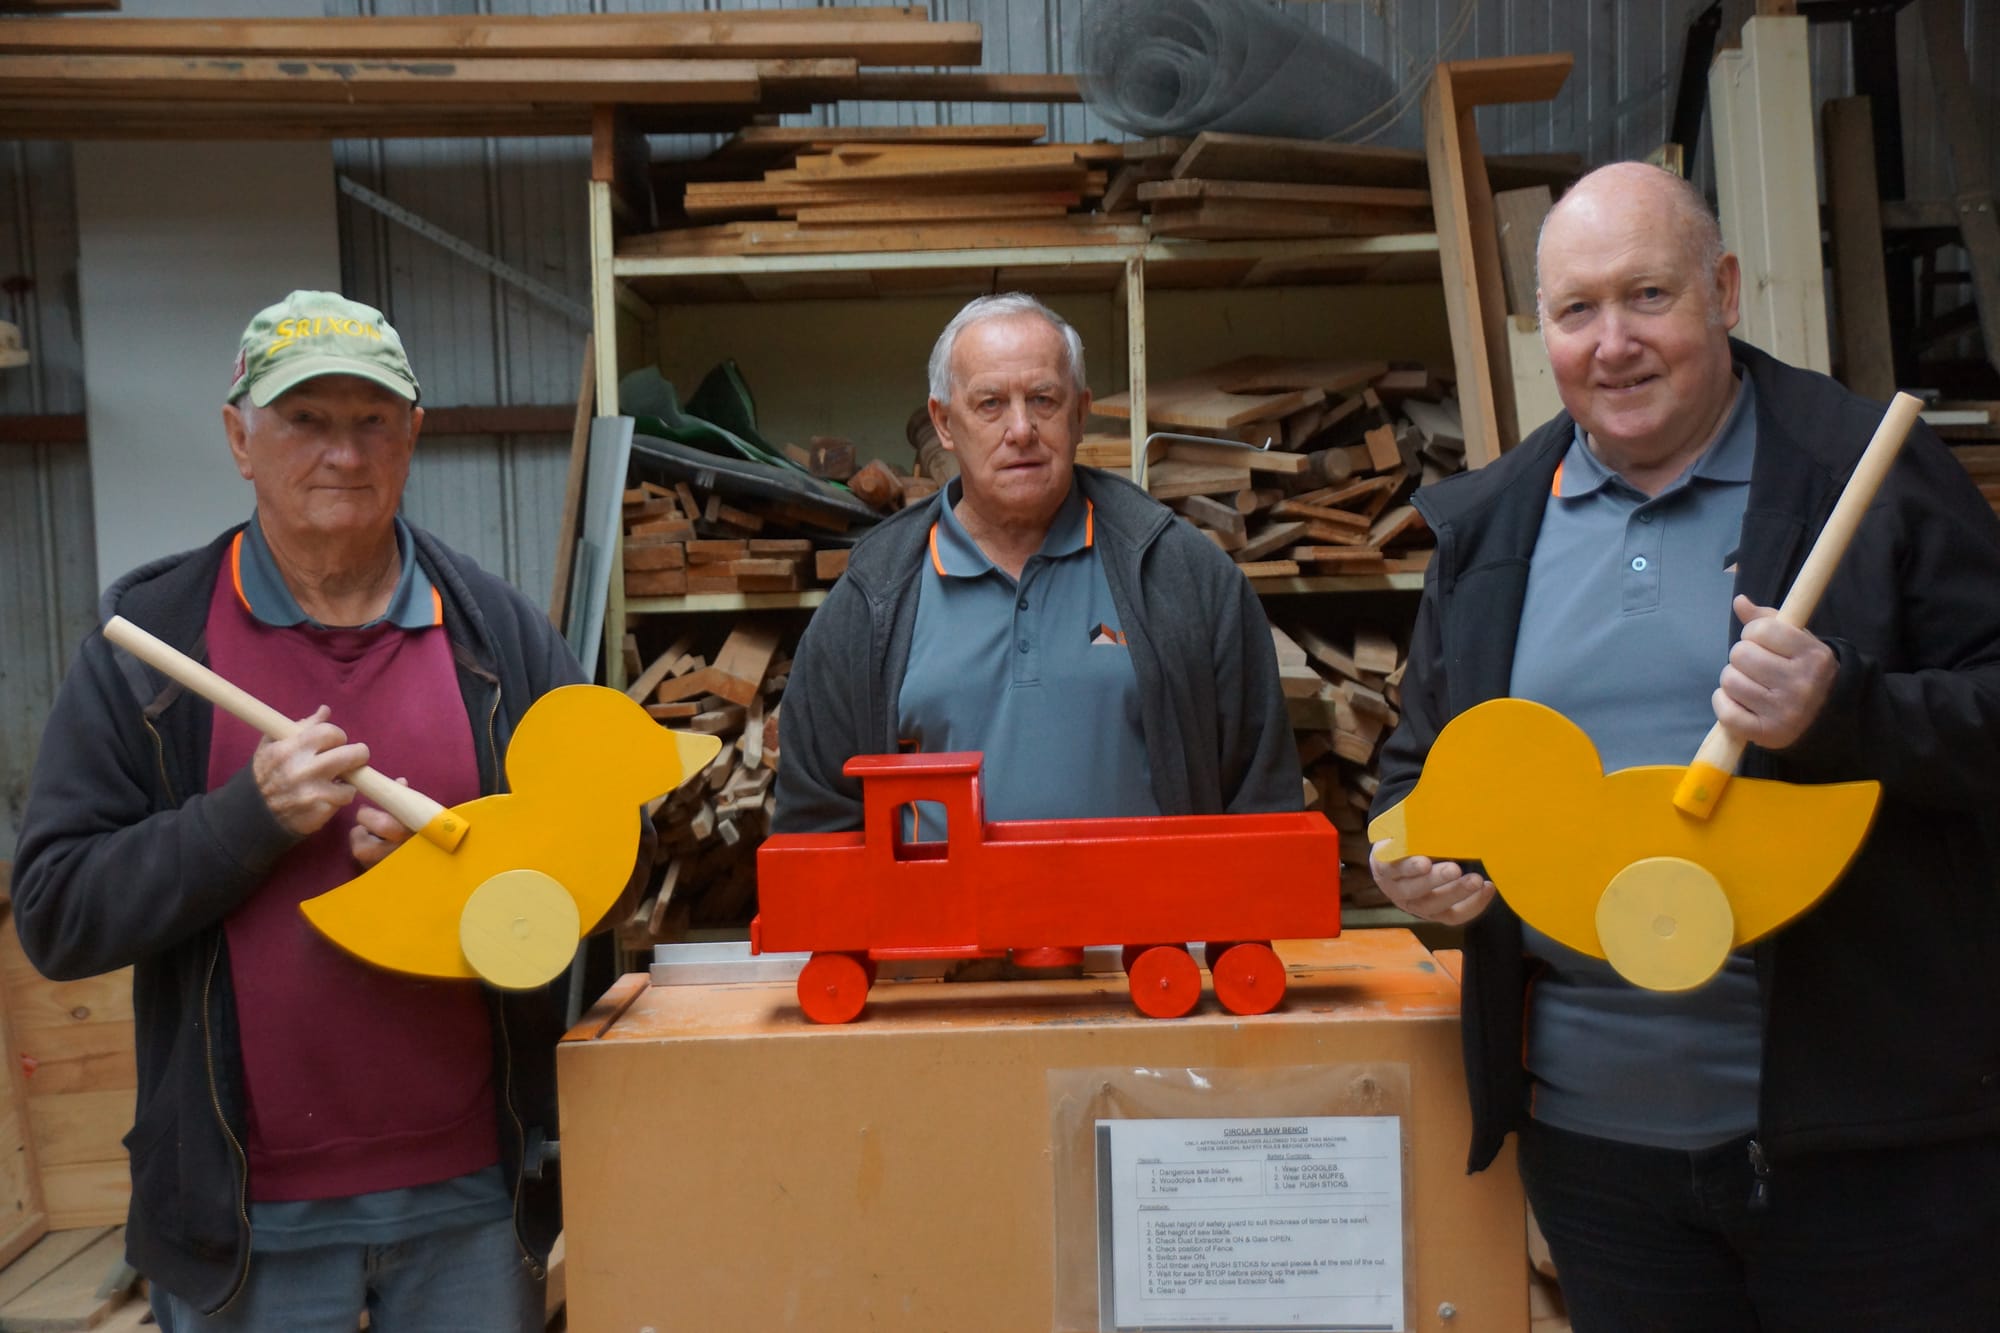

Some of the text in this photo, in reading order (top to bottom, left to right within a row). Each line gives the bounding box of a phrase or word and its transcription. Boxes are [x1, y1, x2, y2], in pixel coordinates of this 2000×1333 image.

[268, 316, 381, 354] SRIXON
[1223, 1126, 1309, 1137] CIRCULAR SAW BENCH
[1159, 1168, 1195, 1177] Dangerous
[1282, 1173, 1300, 1181] Wear
[1301, 1172, 1317, 1180] EAR
[1159, 1176, 1195, 1185] Woodchips
[1299, 1181, 1320, 1189] PUSH
[1321, 1180, 1349, 1189] STICKS
[1154, 1220, 1175, 1229] Adjust
[1176, 1220, 1197, 1229] height
[1198, 1219, 1205, 1227] of
[1206, 1219, 1226, 1228] safety
[1227, 1219, 1247, 1228] guard
[1256, 1218, 1267, 1226] suit
[1269, 1217, 1300, 1226] thickness
[1301, 1217, 1308, 1225] of
[1309, 1216, 1330, 1225] timber
[1331, 1216, 1338, 1224] to
[1339, 1216, 1348, 1224] be
[1167, 1228, 1188, 1237] height
[1189, 1228, 1196, 1236] of
[1177, 1236, 1193, 1244] Dust
[1194, 1236, 1223, 1244] Extractor
[1251, 1235, 1268, 1243] Gate
[1155, 1245, 1176, 1253] Check
[1178, 1245, 1203, 1254] position
[1204, 1244, 1211, 1252] of
[1156, 1253, 1178, 1261] Switch
[1156, 1261, 1168, 1269] Cut
[1169, 1261, 1190, 1269] timber
[1191, 1261, 1209, 1270] using
[1210, 1261, 1231, 1269] PUSH
[1232, 1260, 1259, 1268] STICKS
[1260, 1260, 1270, 1268] for
[1270, 1259, 1288, 1267] small
[1289, 1260, 1312, 1268] pieces
[1328, 1258, 1338, 1266] the
[1339, 1258, 1353, 1266] end
[1354, 1258, 1361, 1266] of
[1206, 1269, 1226, 1277] STOP
[1227, 1269, 1248, 1277] before
[1250, 1269, 1273, 1278] picking
[1284, 1268, 1295, 1276] the
[1188, 1278, 1203, 1286] OFF
[1204, 1278, 1218, 1286] and
[1218, 1278, 1236, 1286] close
[1237, 1277, 1267, 1286] Extractor
[1156, 1286, 1176, 1294] Clean
[1177, 1287, 1186, 1295] up
